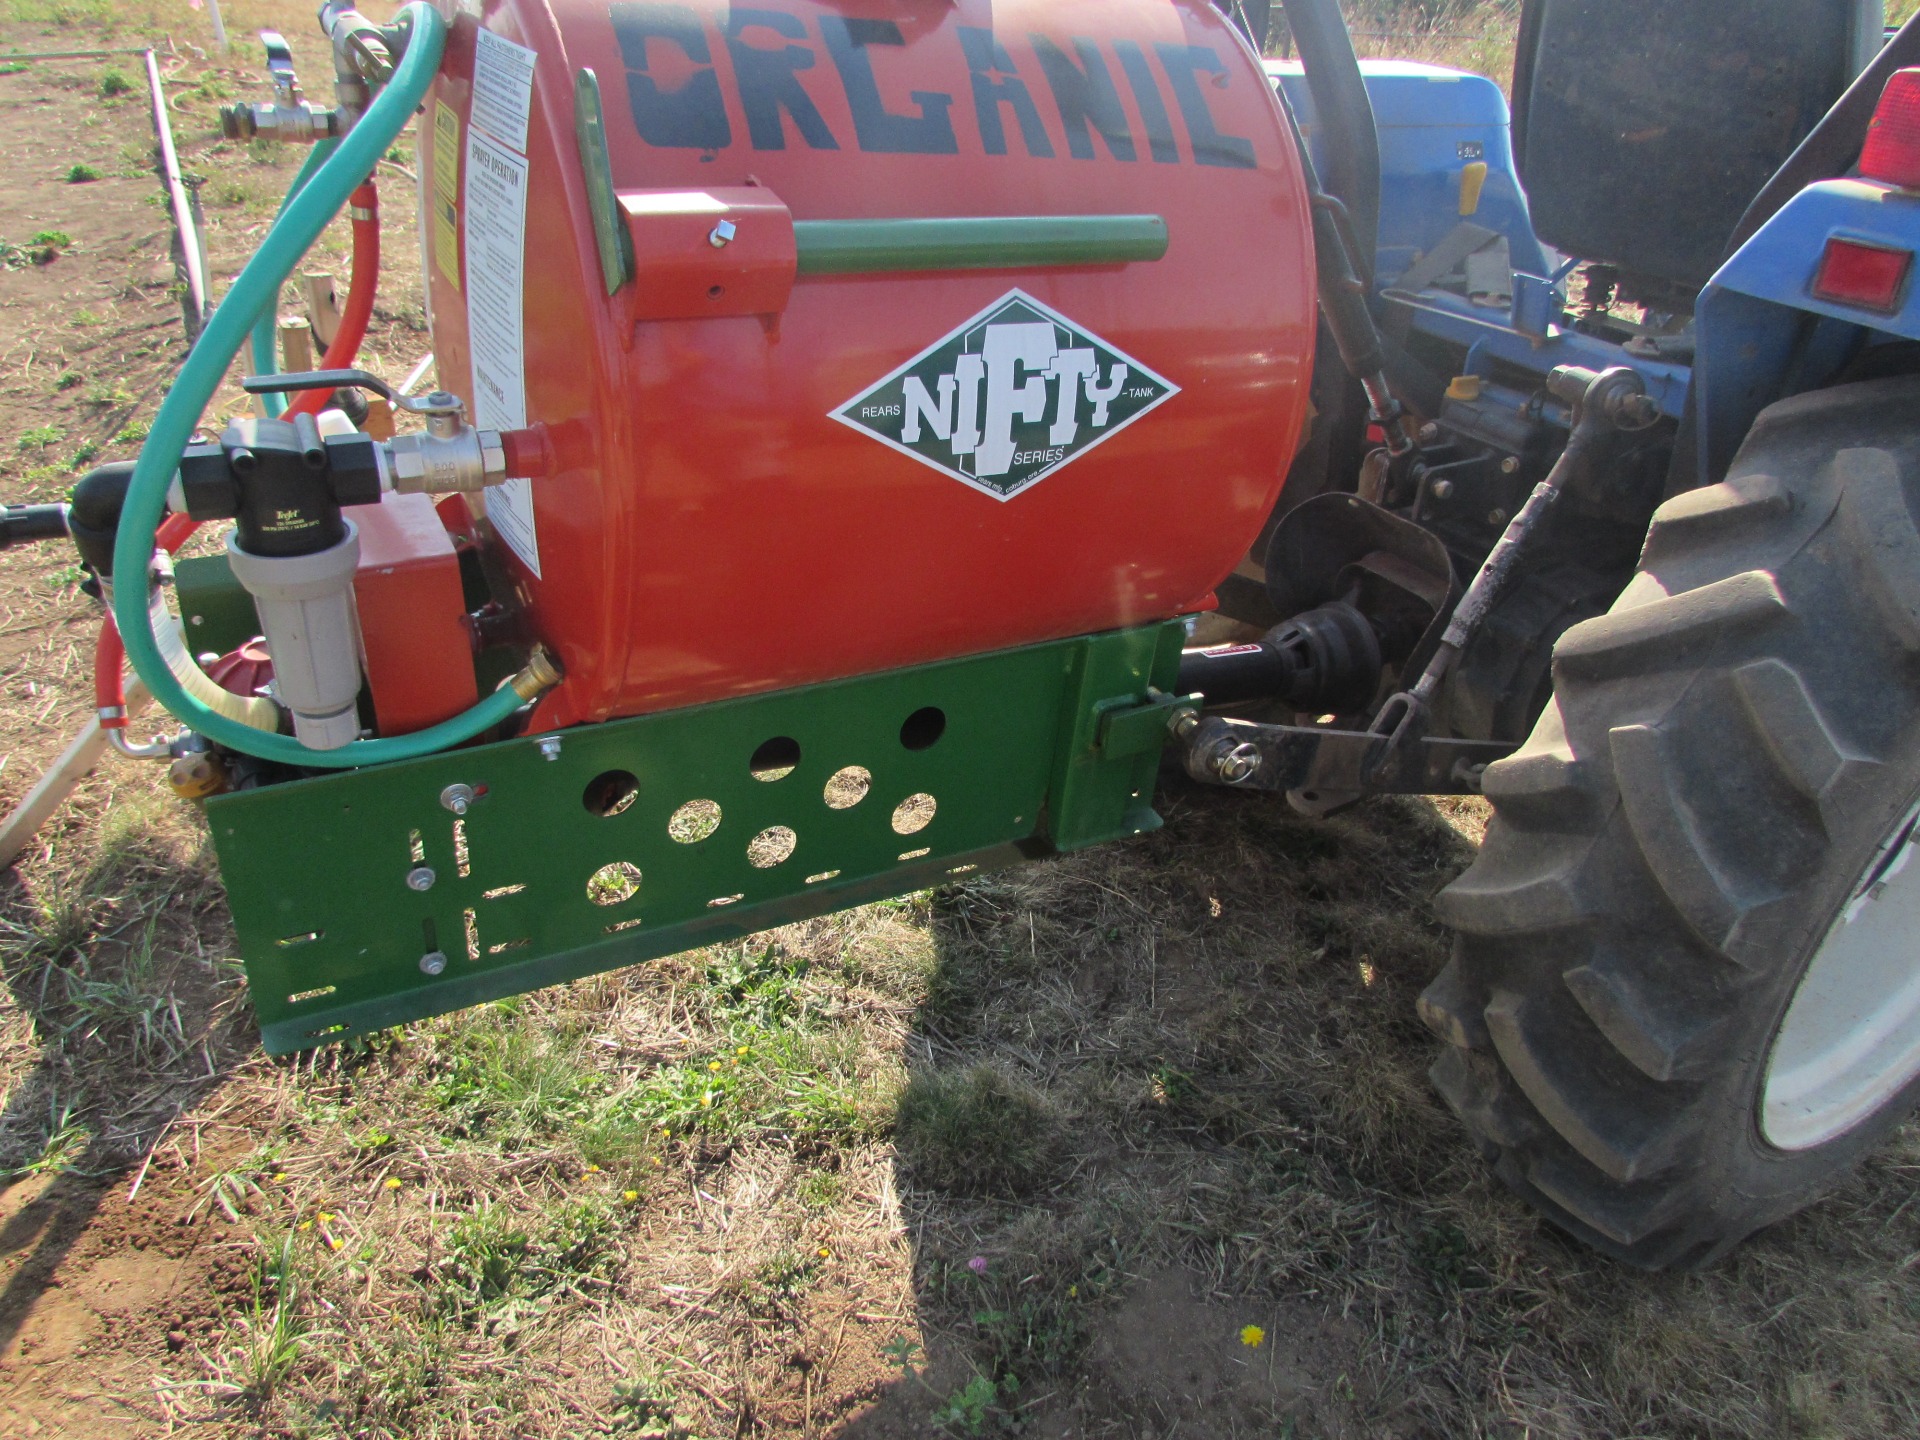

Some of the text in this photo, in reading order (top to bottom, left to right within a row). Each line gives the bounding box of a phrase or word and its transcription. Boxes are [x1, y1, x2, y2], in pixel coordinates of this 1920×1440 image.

[609, 2, 1257, 170] ORGANIC
[472, 143, 519, 187] SPRAYER OPERATION
[862, 404, 901, 418] REARS
[901, 323, 1128, 476] NIFTY
[1013, 448, 1064, 466] SERIES
